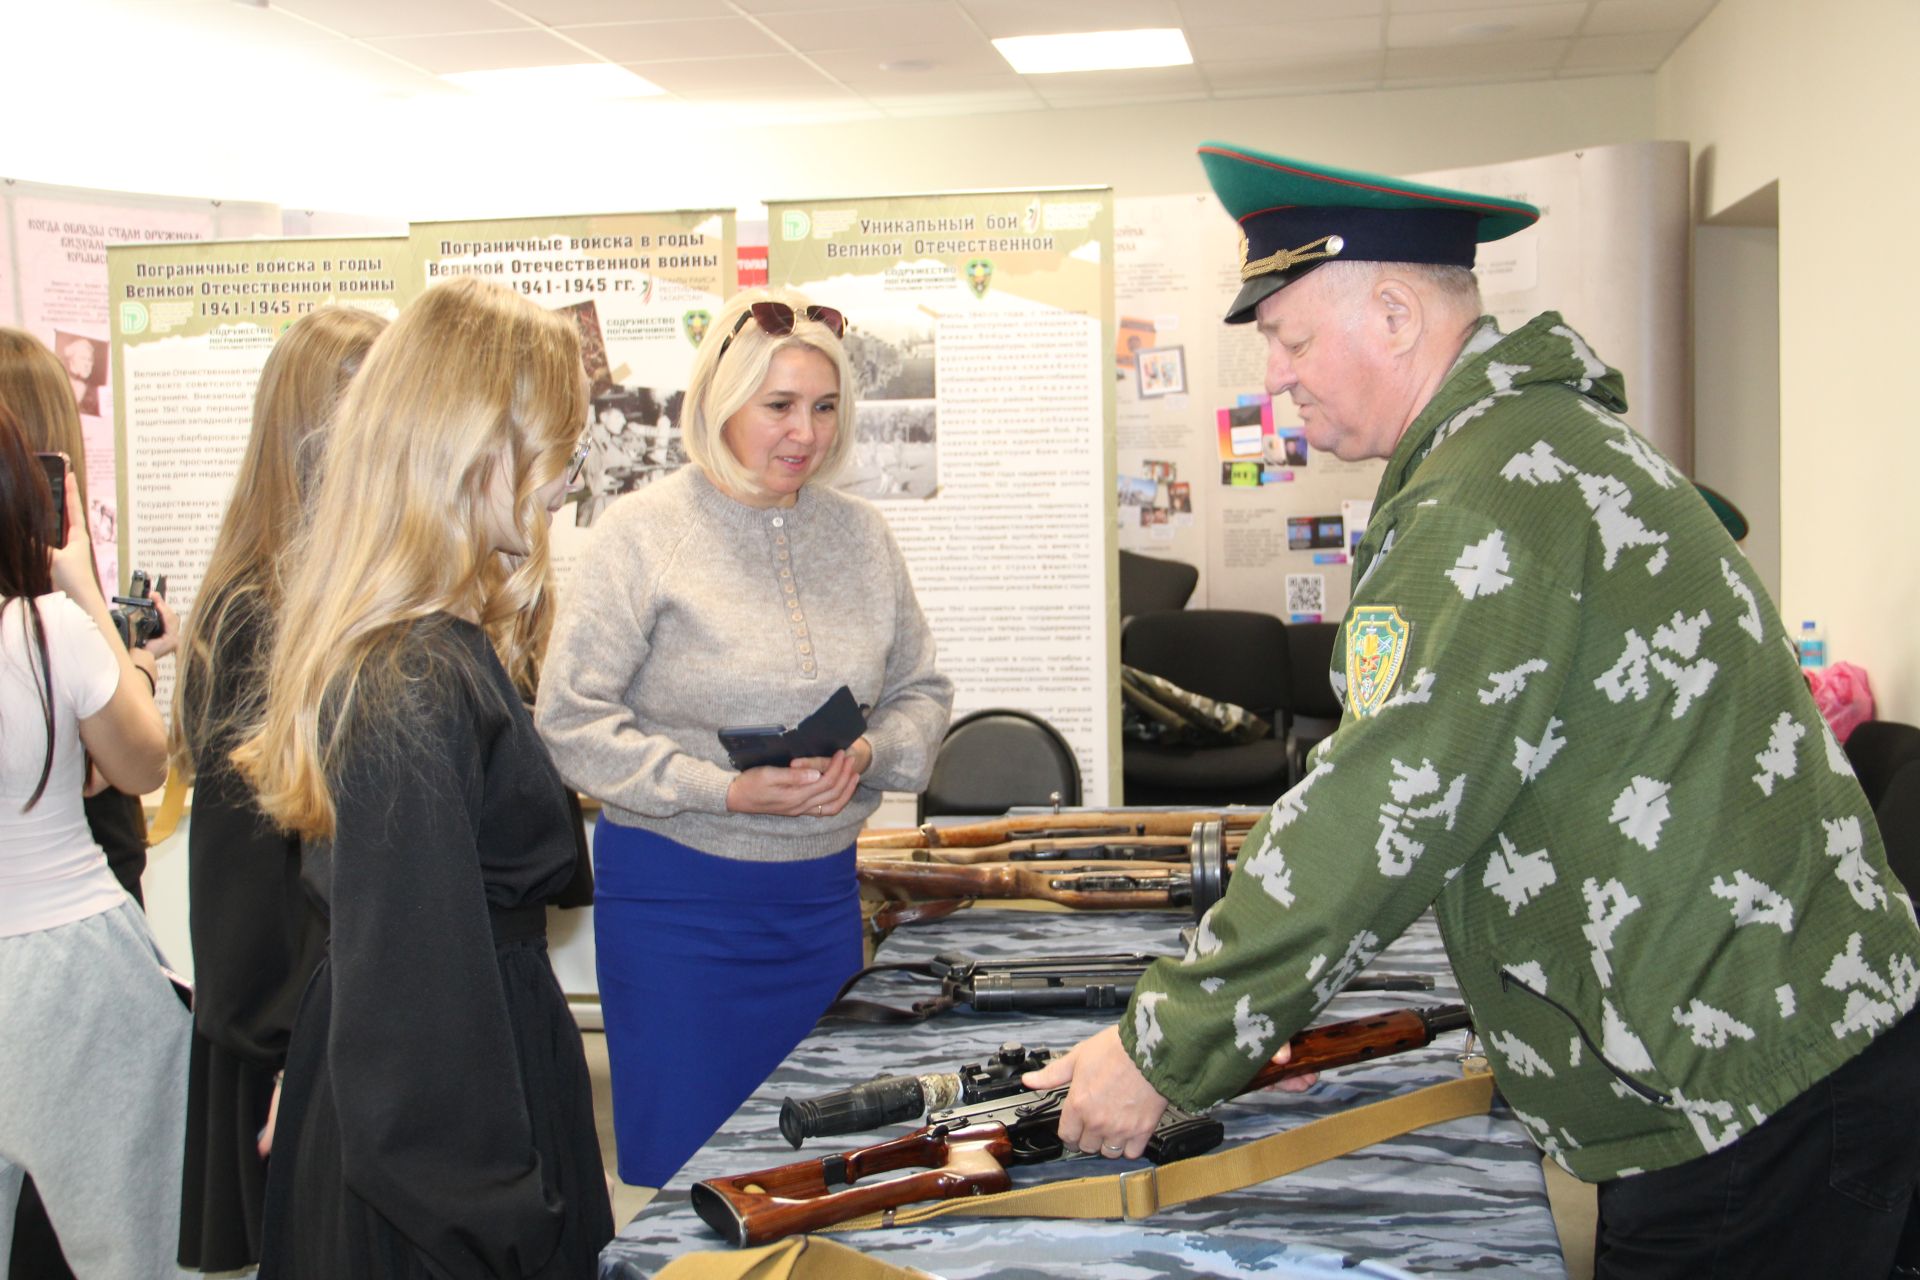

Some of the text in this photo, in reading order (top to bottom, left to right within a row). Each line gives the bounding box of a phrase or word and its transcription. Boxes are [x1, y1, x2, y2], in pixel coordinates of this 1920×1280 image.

[861, 213, 974, 234] Уникальный
[987, 211, 1018, 230] бой
[441, 232, 704, 257] Пограничные войска в годы
[828, 236, 1053, 258] Великой Отечественной
[137, 257, 382, 279] Пограничные войска в годы
[512, 256, 650, 274] Отечественной
[659, 252, 718, 269] войны
[126, 277, 395, 298] Великой Отечественной войны
[512, 279, 635, 295] 1941-1945 гг.
[202, 300, 291, 316] 1941-1945
